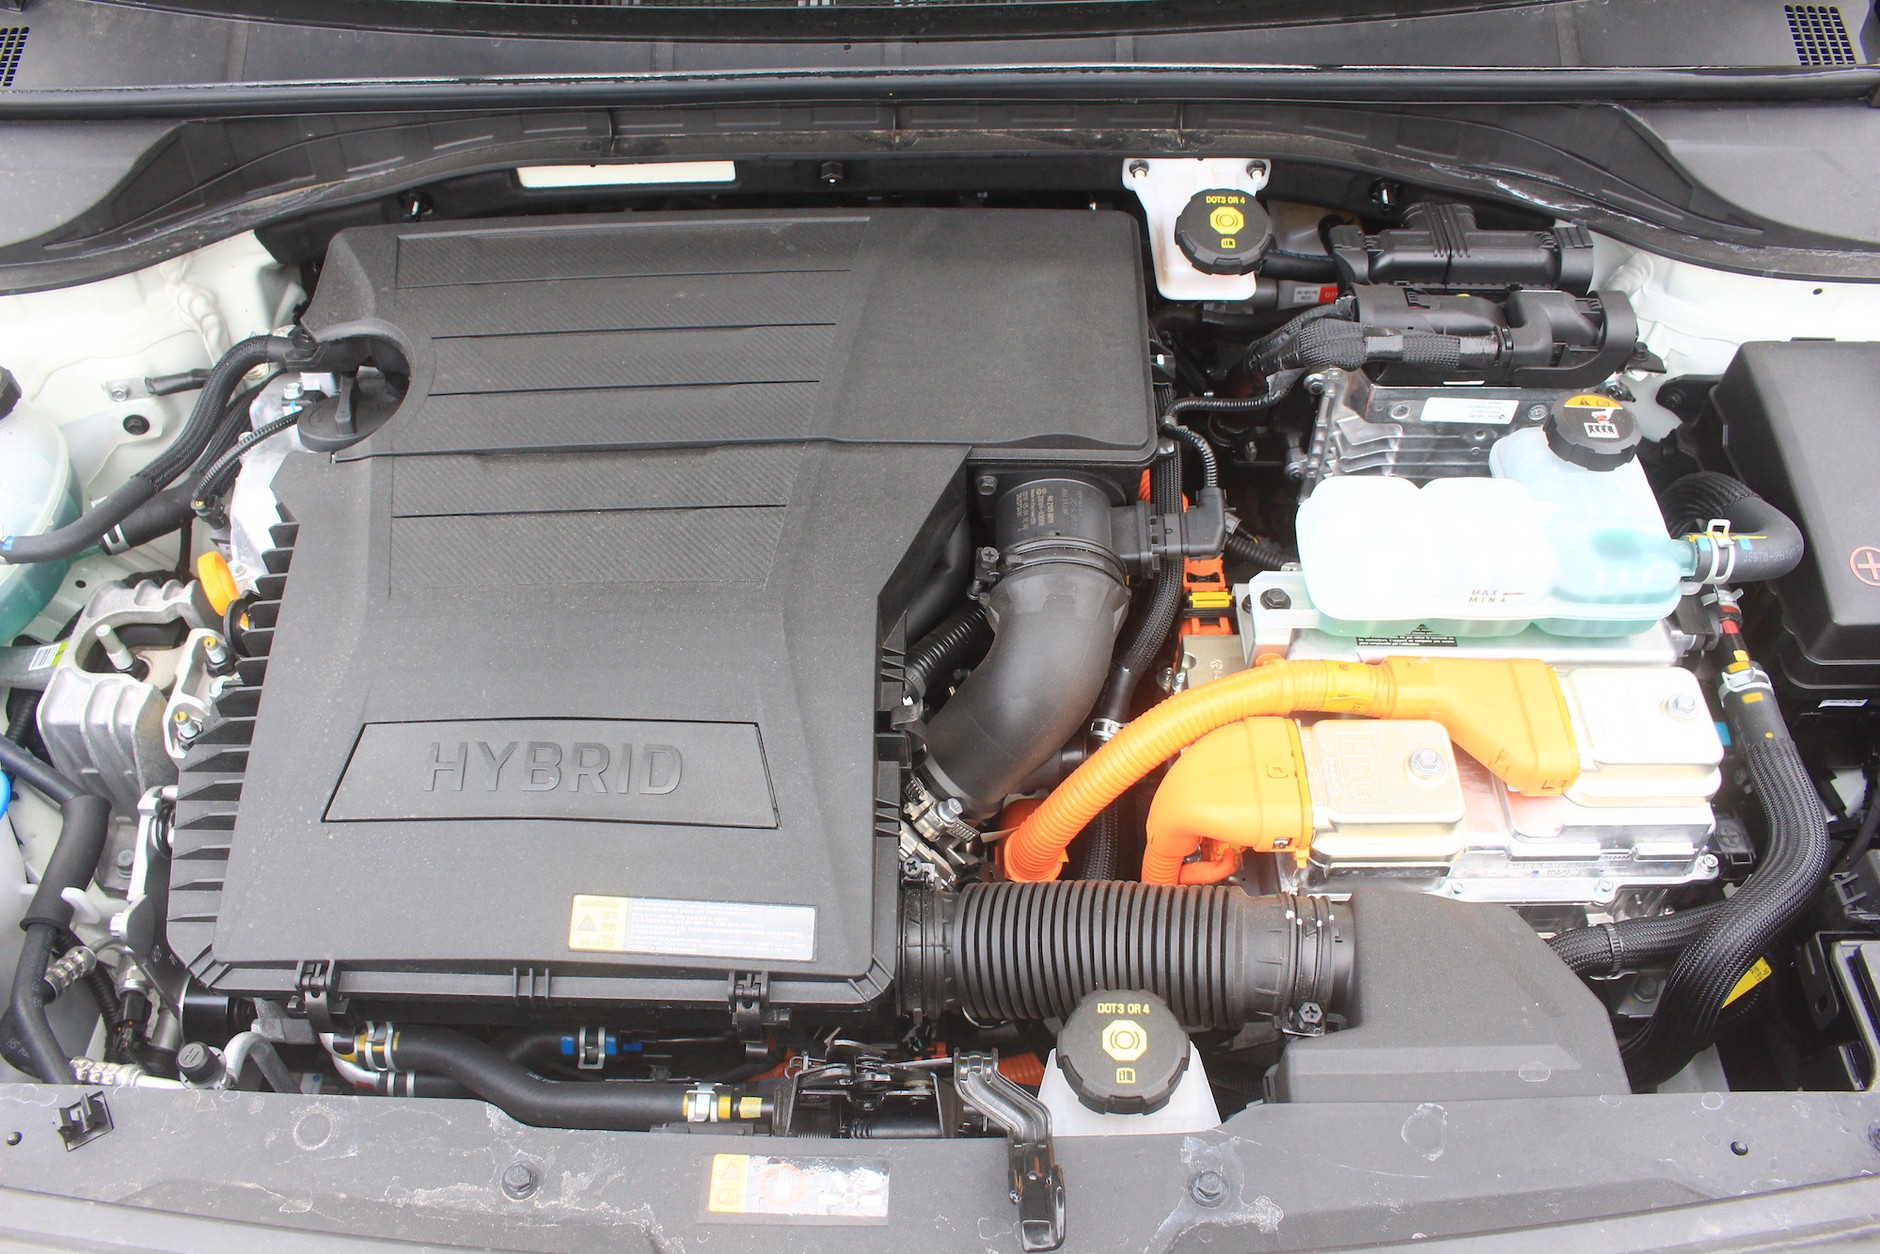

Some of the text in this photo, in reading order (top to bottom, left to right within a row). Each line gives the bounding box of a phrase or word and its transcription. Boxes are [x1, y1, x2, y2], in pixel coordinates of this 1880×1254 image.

[1205, 196, 1246, 204] DOT3 OR 4
[1471, 589, 1499, 597] MAX
[423, 740, 683, 795] HYBRID
[1097, 1003, 1150, 1014] DOT3 OR 4
